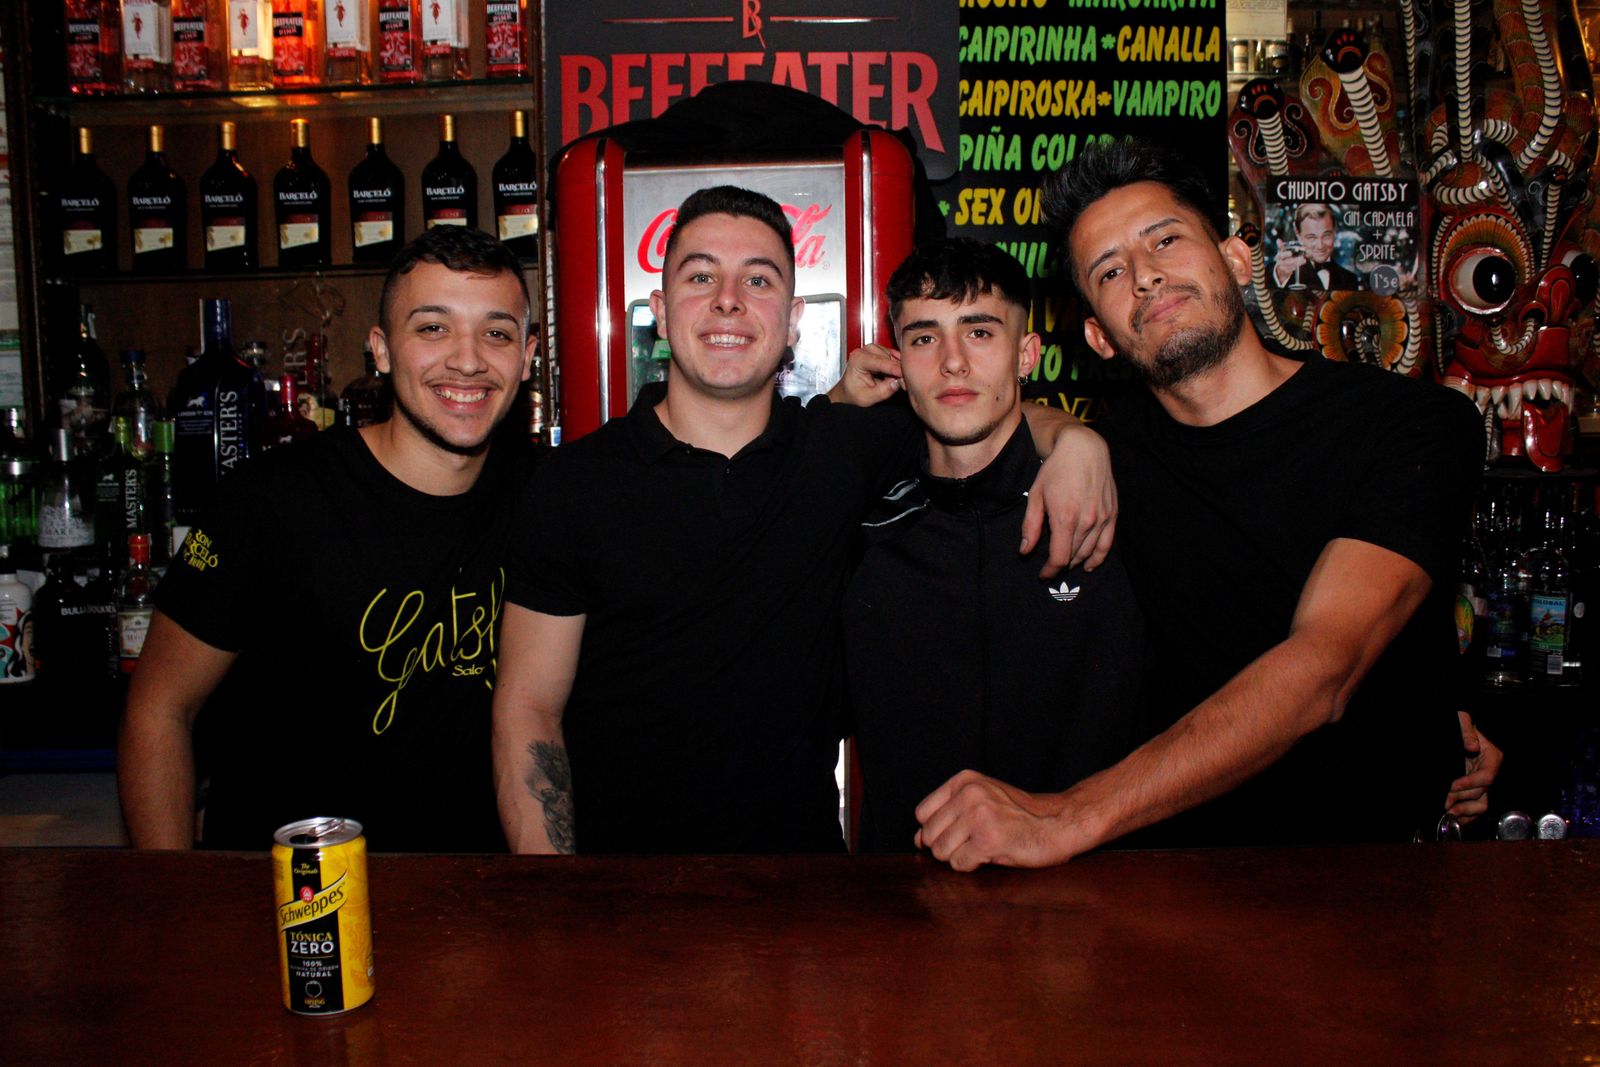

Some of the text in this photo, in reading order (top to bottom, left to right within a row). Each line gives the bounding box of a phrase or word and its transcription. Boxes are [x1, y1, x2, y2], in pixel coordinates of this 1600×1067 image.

[1117, 25, 1220, 62] CANALLA
[1113, 79, 1221, 120] VAMPIRO
[959, 125, 1022, 172] PIÑA
[353, 187, 391, 198] BARCELÓ
[426, 185, 465, 196] BARCELÓ
[499, 181, 538, 192] BARCELÓ
[1276, 181, 1409, 203] CHUPITO GATSBY
[132, 195, 171, 205] BARCELÓ
[205, 193, 243, 203] BARCELÓ
[279, 190, 317, 200] BARCELÓ
[954, 187, 1006, 225] SEX
[1363, 211, 1414, 228] CARMELA
[1359, 244, 1396, 262] SPRITE
[220, 390, 238, 476] ASTER'S
[279, 885, 344, 926] Schweppes
[290, 930, 334, 943] TÓNICA
[290, 941, 335, 955] ZERO
[295, 970, 332, 979] NATURAL
